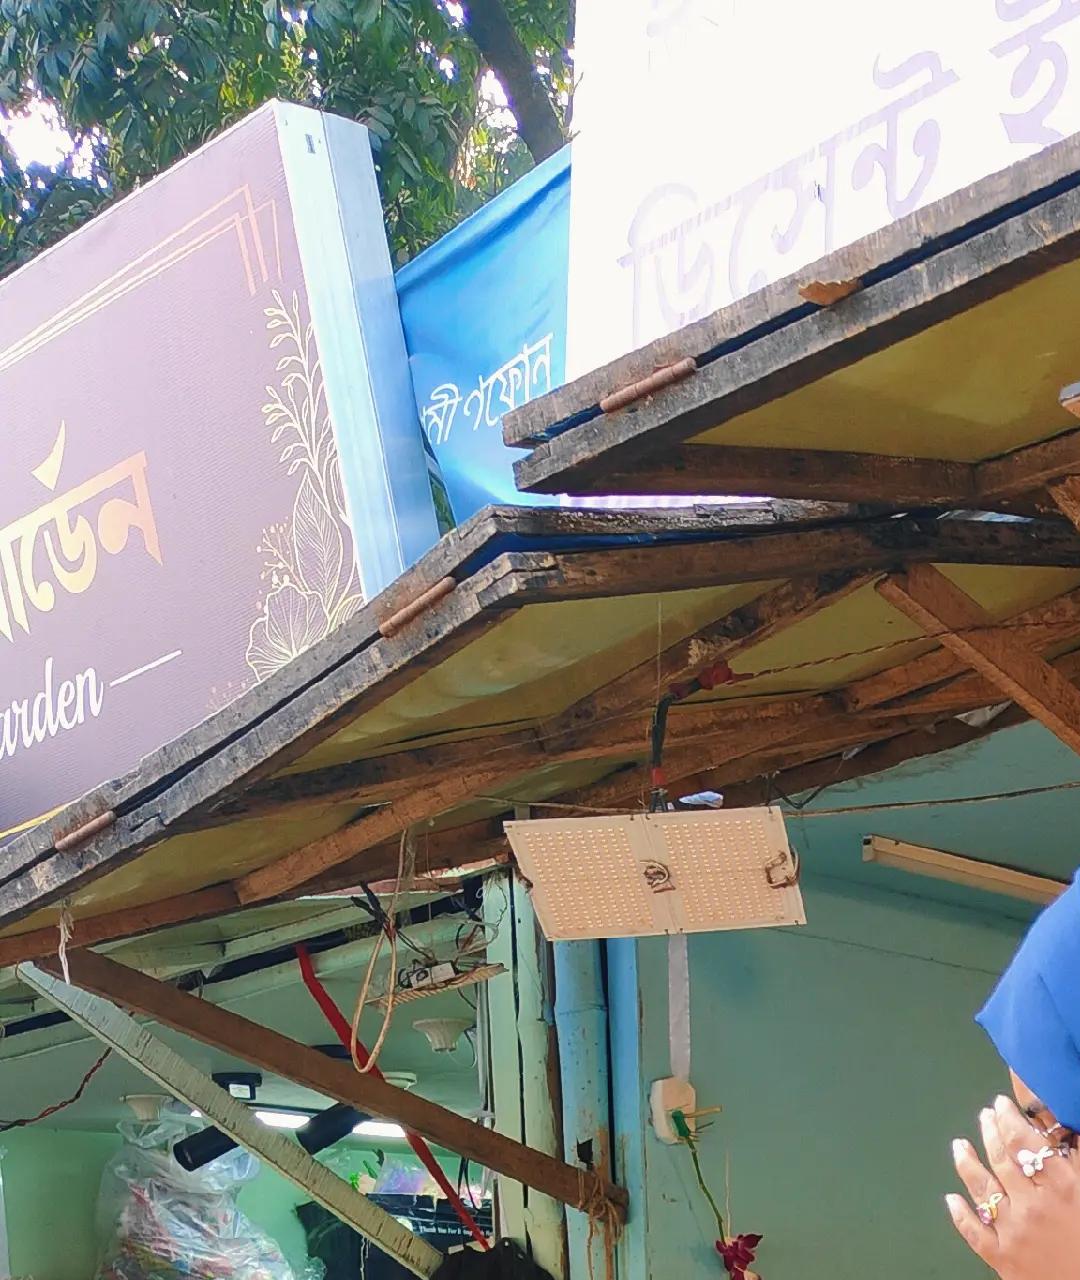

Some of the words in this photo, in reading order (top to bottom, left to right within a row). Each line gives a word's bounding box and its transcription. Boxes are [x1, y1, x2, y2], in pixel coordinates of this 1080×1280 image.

[421, 332, 554, 445] মীণফোন
[0, 420, 164, 644] ার্ডেন
[0, 657, 104, 760] arden
